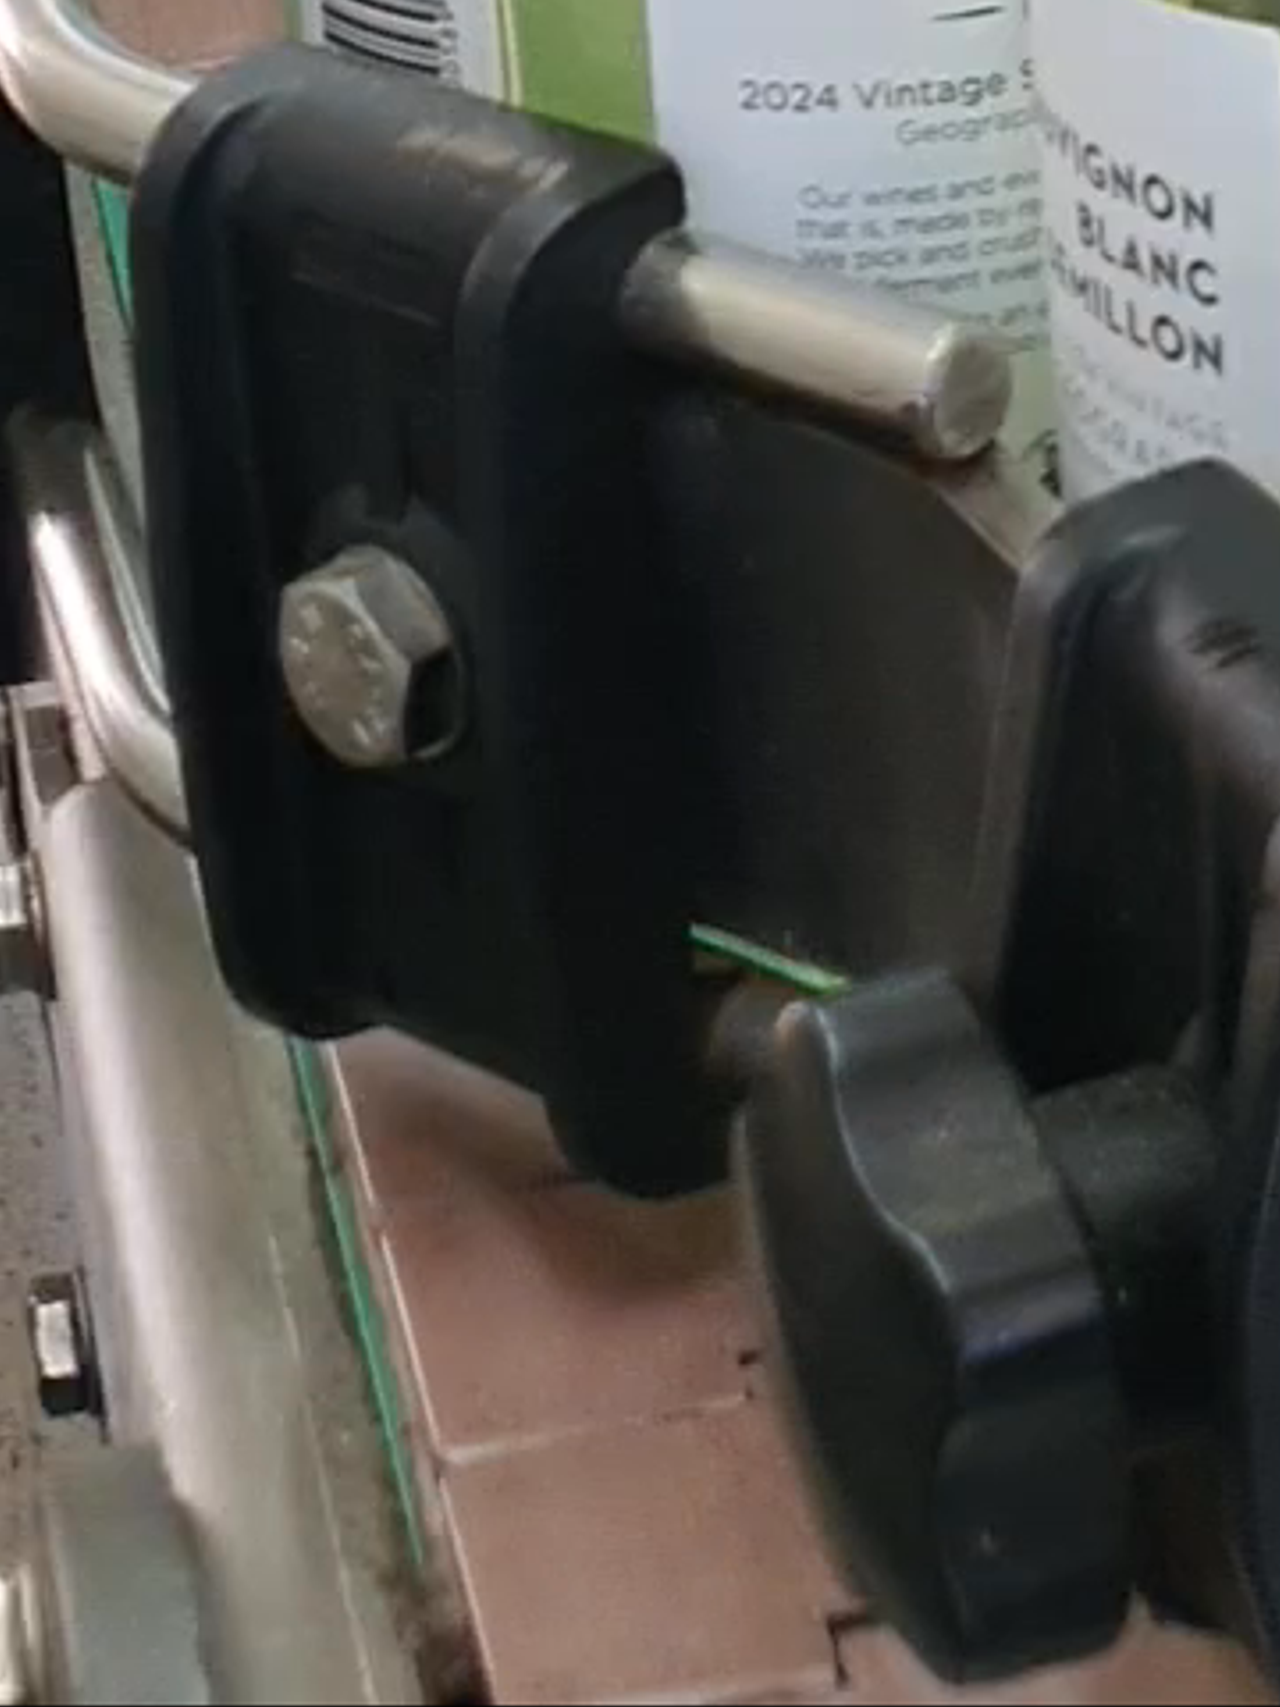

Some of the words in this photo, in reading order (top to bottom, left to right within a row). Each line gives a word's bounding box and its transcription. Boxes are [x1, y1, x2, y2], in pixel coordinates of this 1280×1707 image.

[738, 78, 840, 114] 2024
[852, 70, 1009, 111] Vintage
[1076, 199, 1219, 307] BLANC
